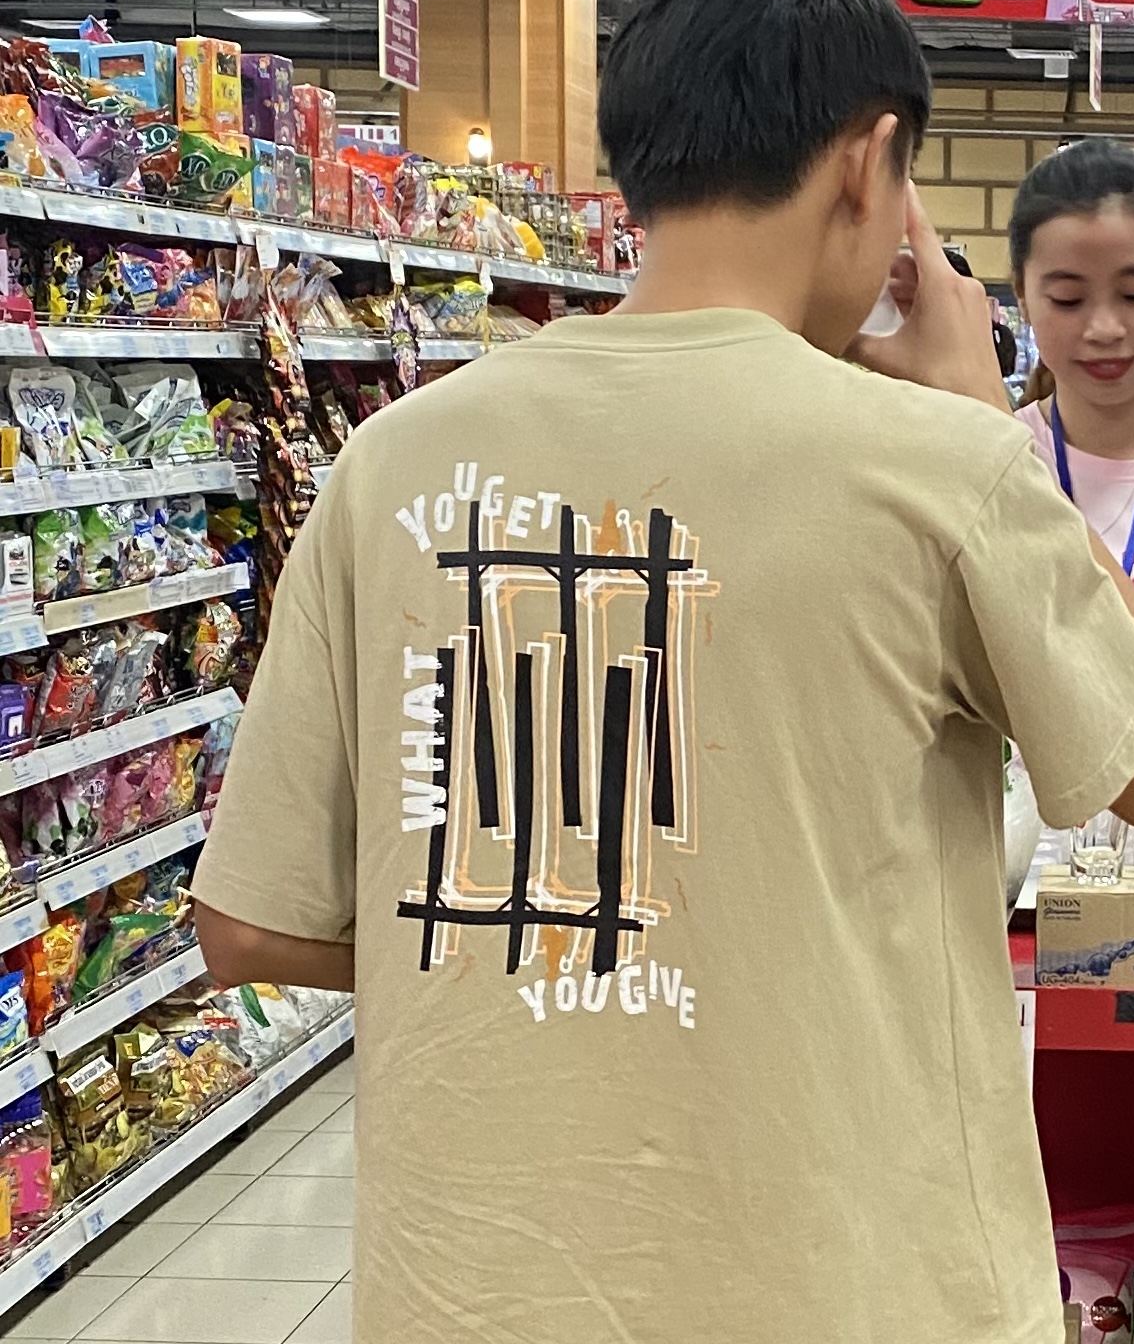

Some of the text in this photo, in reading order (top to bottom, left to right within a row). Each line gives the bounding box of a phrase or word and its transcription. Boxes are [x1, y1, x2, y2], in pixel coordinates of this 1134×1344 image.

[395, 462, 561, 552] YOU GET
[401, 646, 447, 832] WHAT
[1044, 899, 1081, 908] UNION
[517, 971, 611, 1023] YOU
